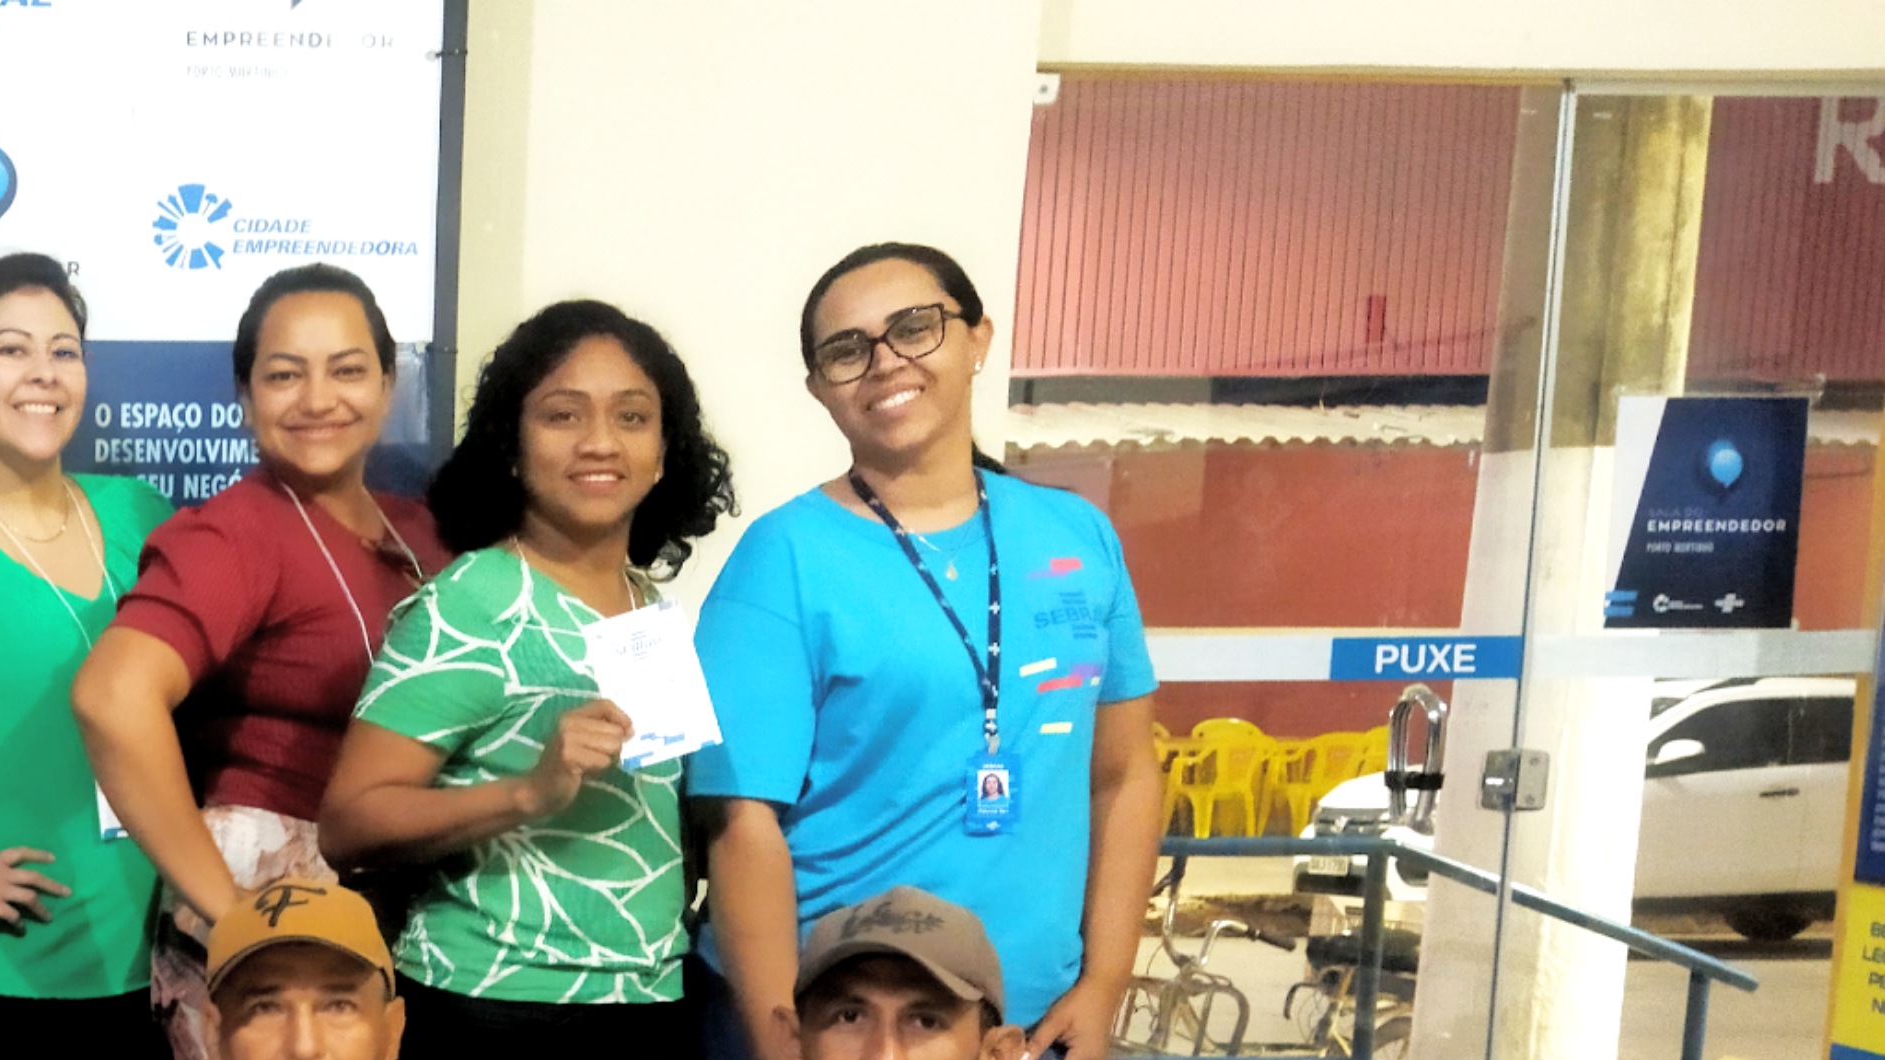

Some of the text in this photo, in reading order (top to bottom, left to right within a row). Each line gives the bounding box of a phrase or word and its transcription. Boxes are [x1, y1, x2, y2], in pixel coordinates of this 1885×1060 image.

[233, 218, 312, 234] CIDADE
[232, 239, 419, 256] EMPREENDEDORA
[94, 402, 244, 433] O ESPAÇO DO
[1647, 519, 1787, 533] EMPREENDEDOR
[1374, 643, 1477, 674] PUXE
